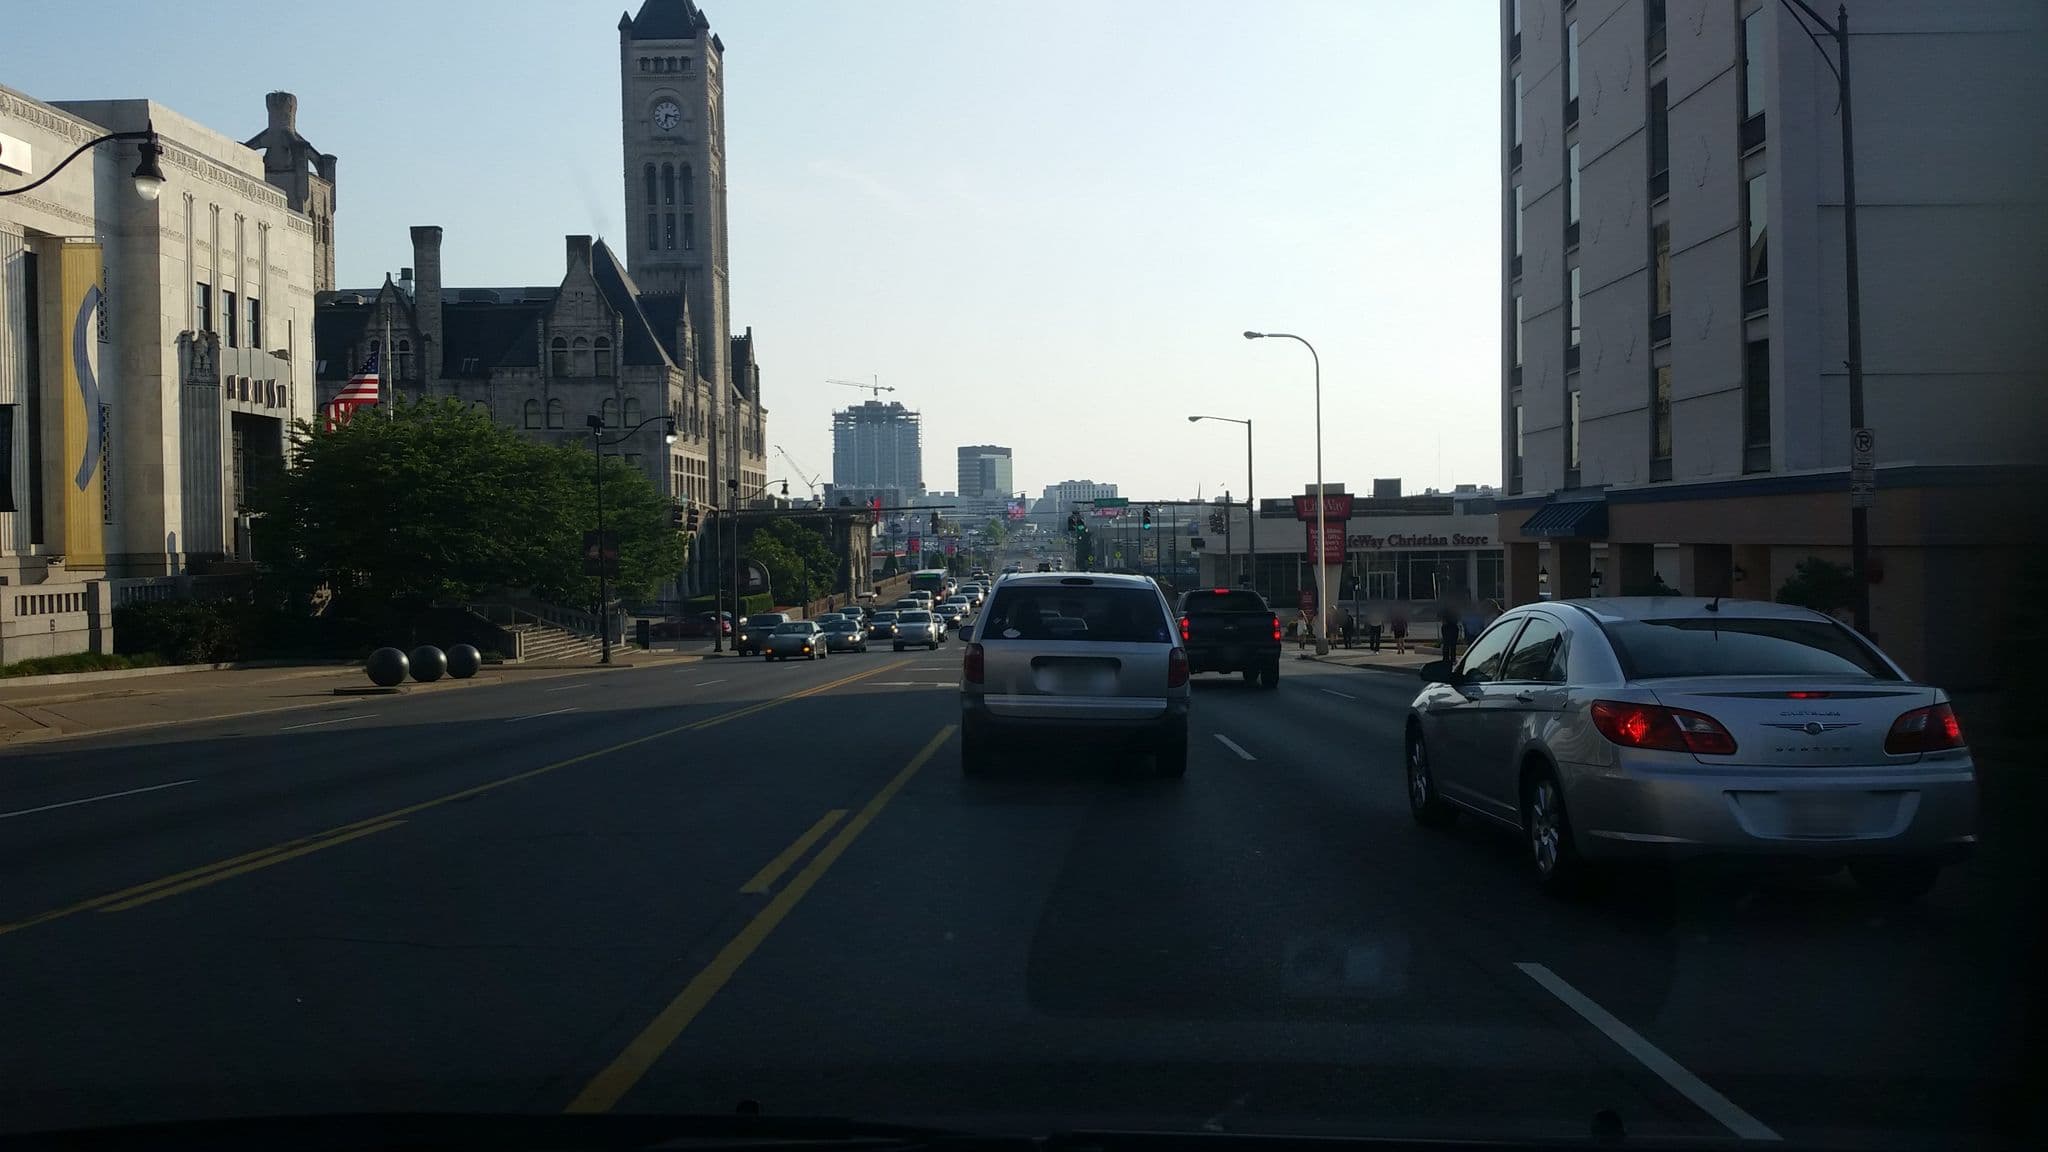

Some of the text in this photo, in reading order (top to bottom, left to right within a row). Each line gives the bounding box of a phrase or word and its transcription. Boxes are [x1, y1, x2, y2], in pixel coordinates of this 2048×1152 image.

[1304, 499, 1345, 513] LifWay
[1348, 534, 1384, 549] feWay
[1387, 533, 1448, 546] Christian
[1452, 533, 1489, 546] Store
